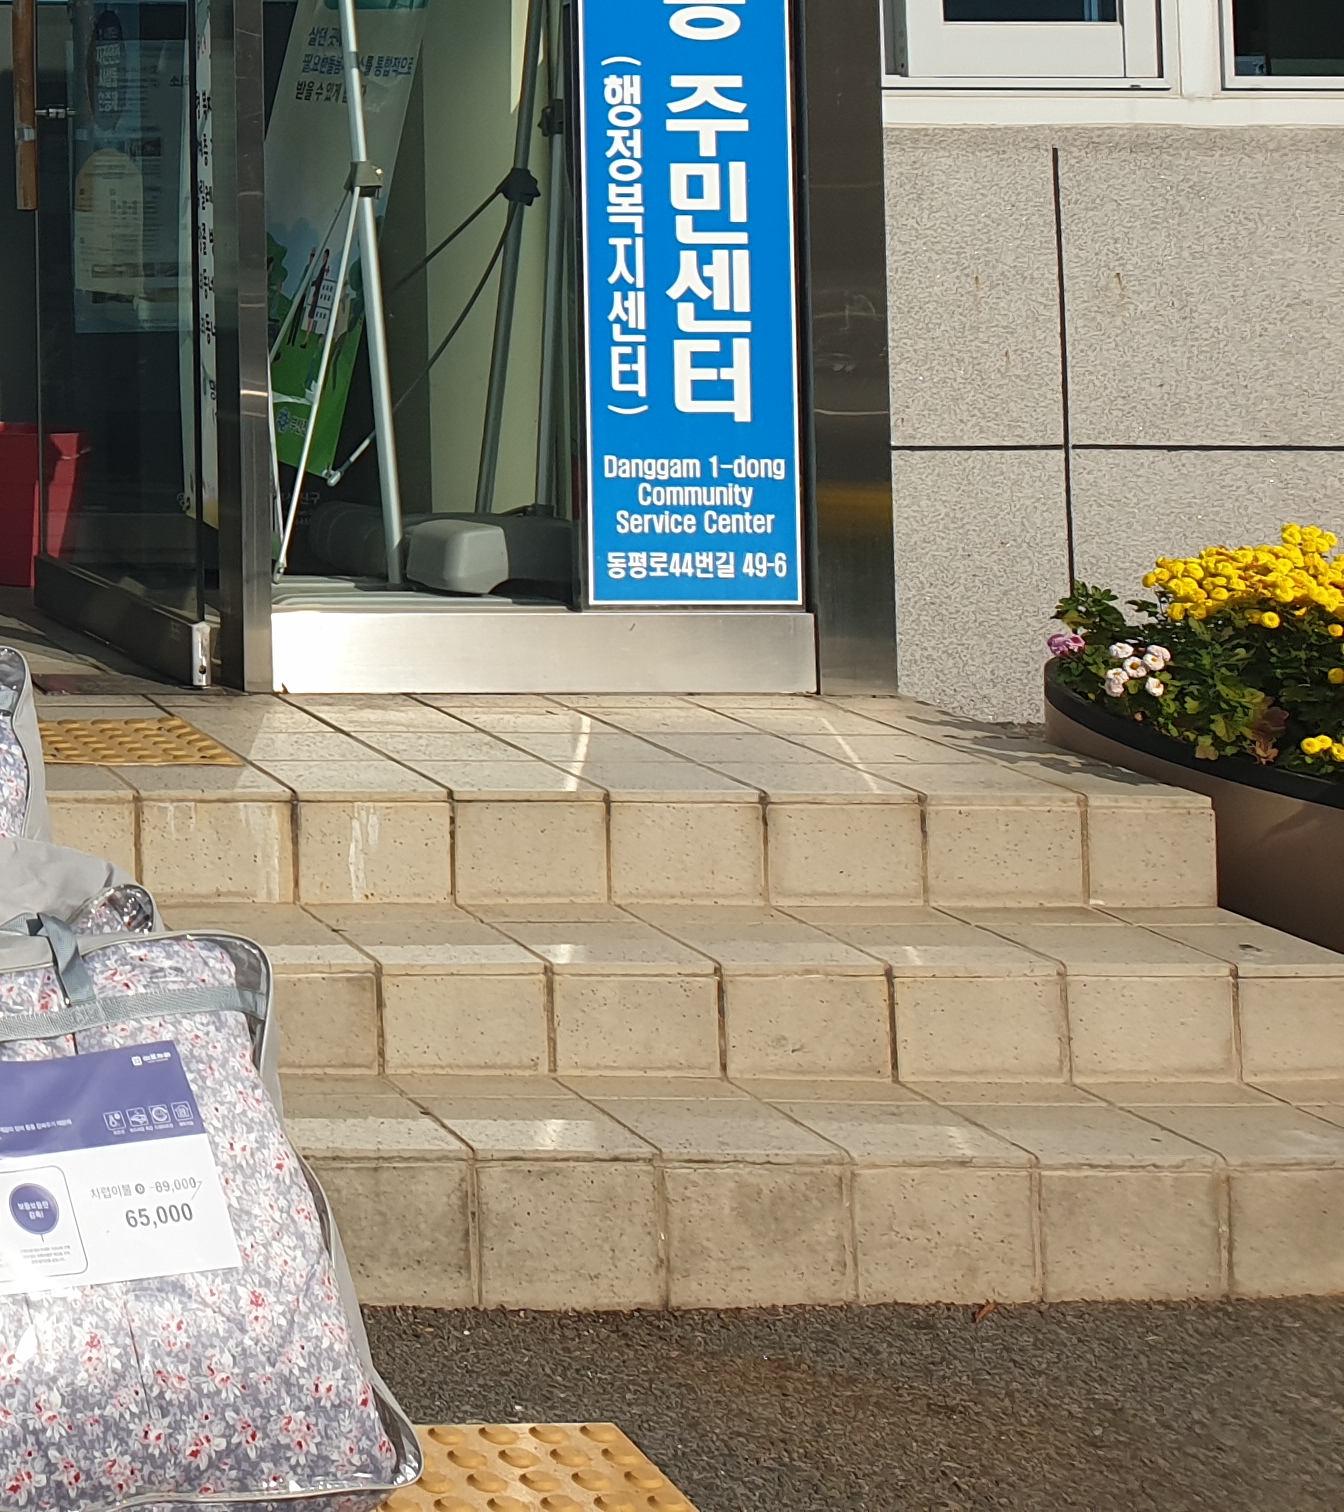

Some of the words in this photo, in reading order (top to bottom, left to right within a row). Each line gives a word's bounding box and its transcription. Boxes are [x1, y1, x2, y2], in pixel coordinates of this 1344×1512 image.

[601, 55, 649, 415] (행정복지센터)
[666, 74, 752, 422] 주민센터
[604, 456, 701, 482] Danggam
[709, 456, 786, 480] 1-dong
[638, 483, 753, 509] Community
[616, 511, 697, 535] Service
[704, 511, 775, 535] Center
[607, 552, 736, 579] 동평로44번길
[743, 553, 787, 578] 49-6
[90, 1183, 132, 1200] 차렵이불
[124, 1202, 194, 1230] 65,000
